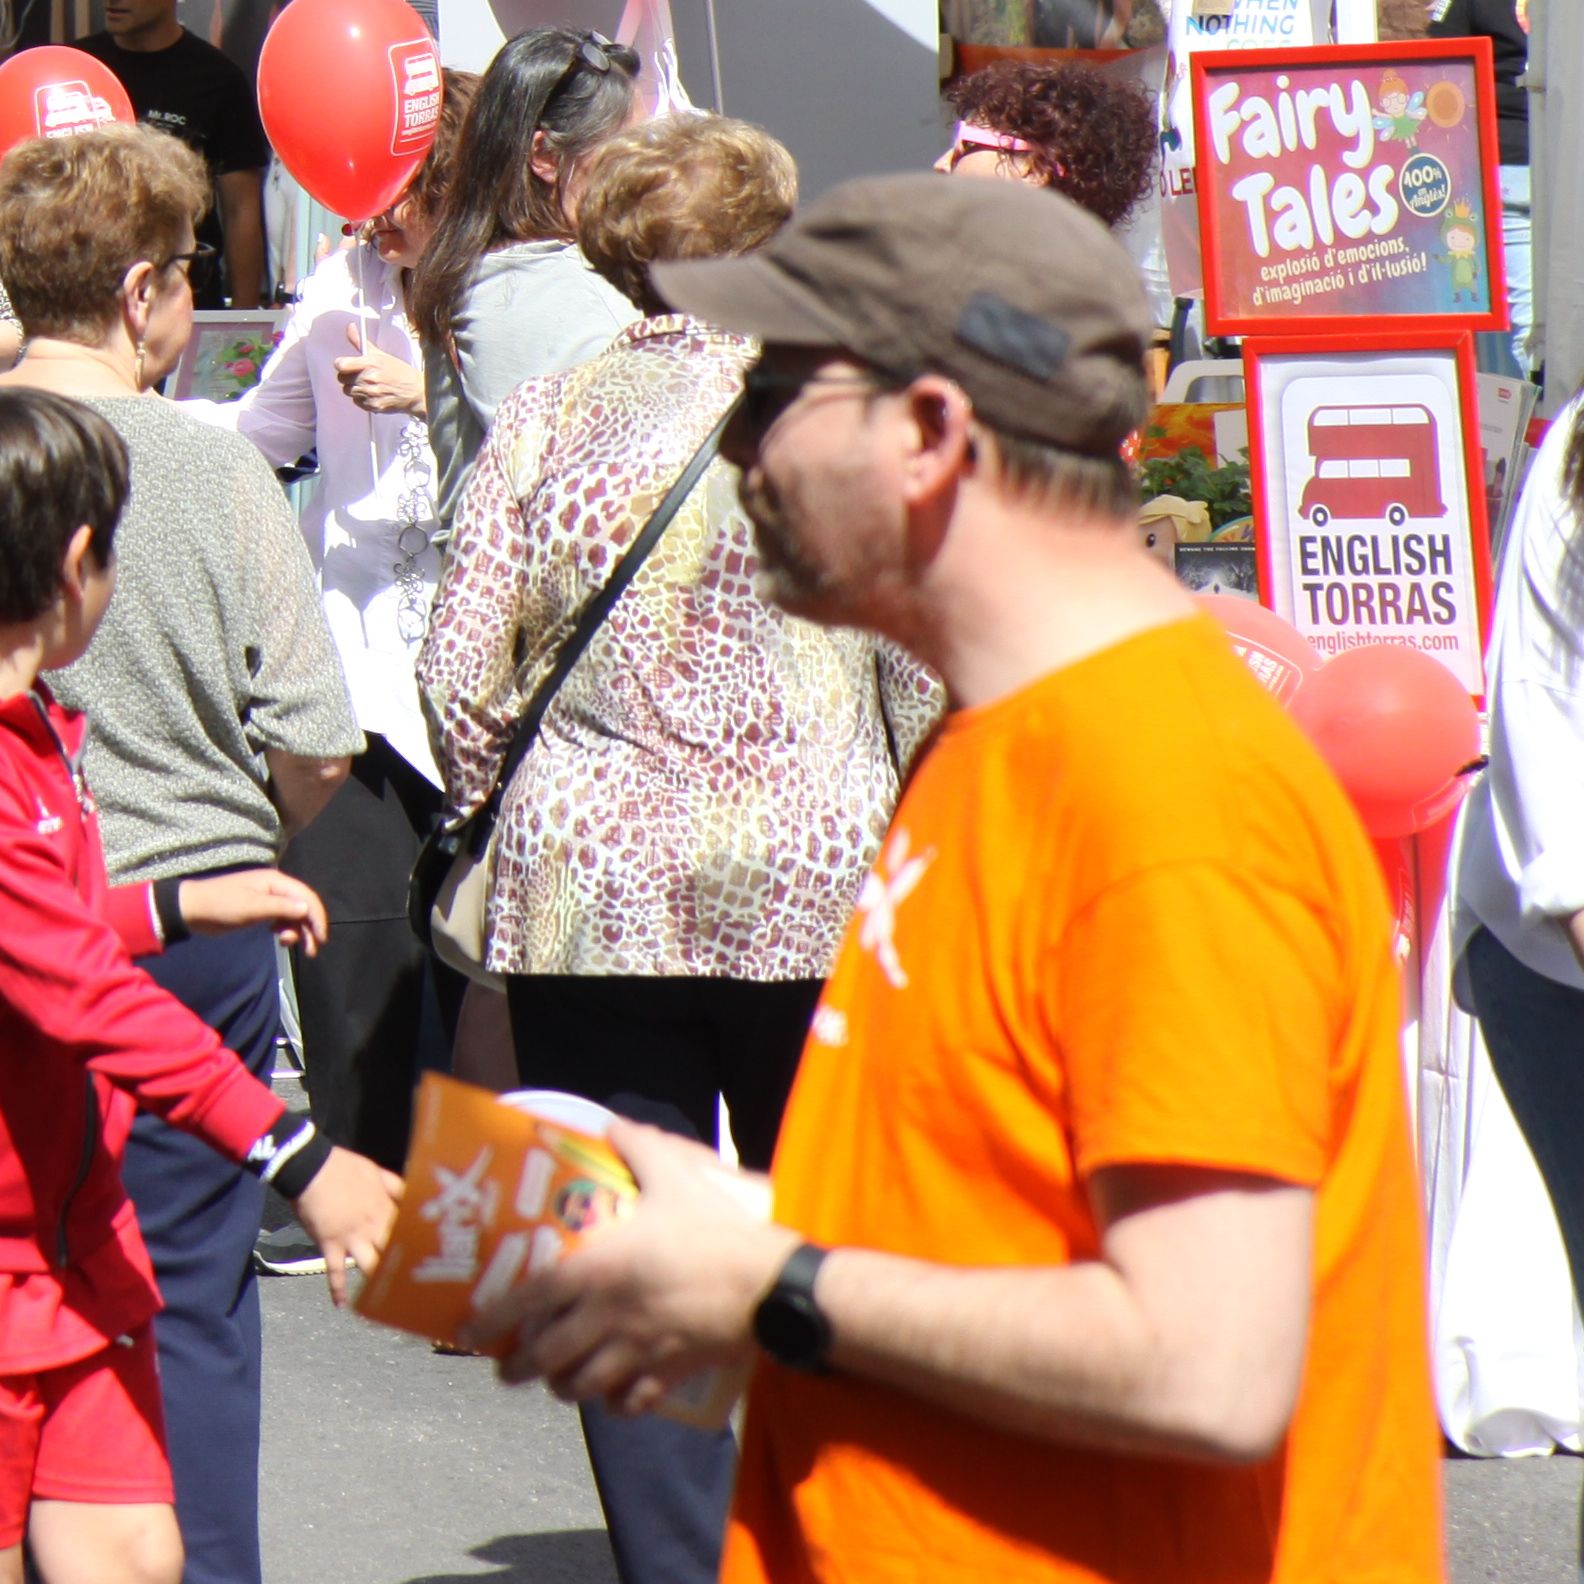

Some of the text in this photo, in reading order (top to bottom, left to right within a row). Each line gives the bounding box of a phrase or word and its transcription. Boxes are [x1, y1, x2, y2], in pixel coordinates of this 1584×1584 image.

[1208, 74, 1375, 170] Fairy
[1403, 164, 1443, 190] 100%
[1231, 163, 1399, 258] Tales
[1260, 250, 1322, 284] explosió
[1348, 267, 1355, 287] i
[1299, 533, 1453, 577] ENGLISH
[1302, 580, 1457, 626] TORRAS
